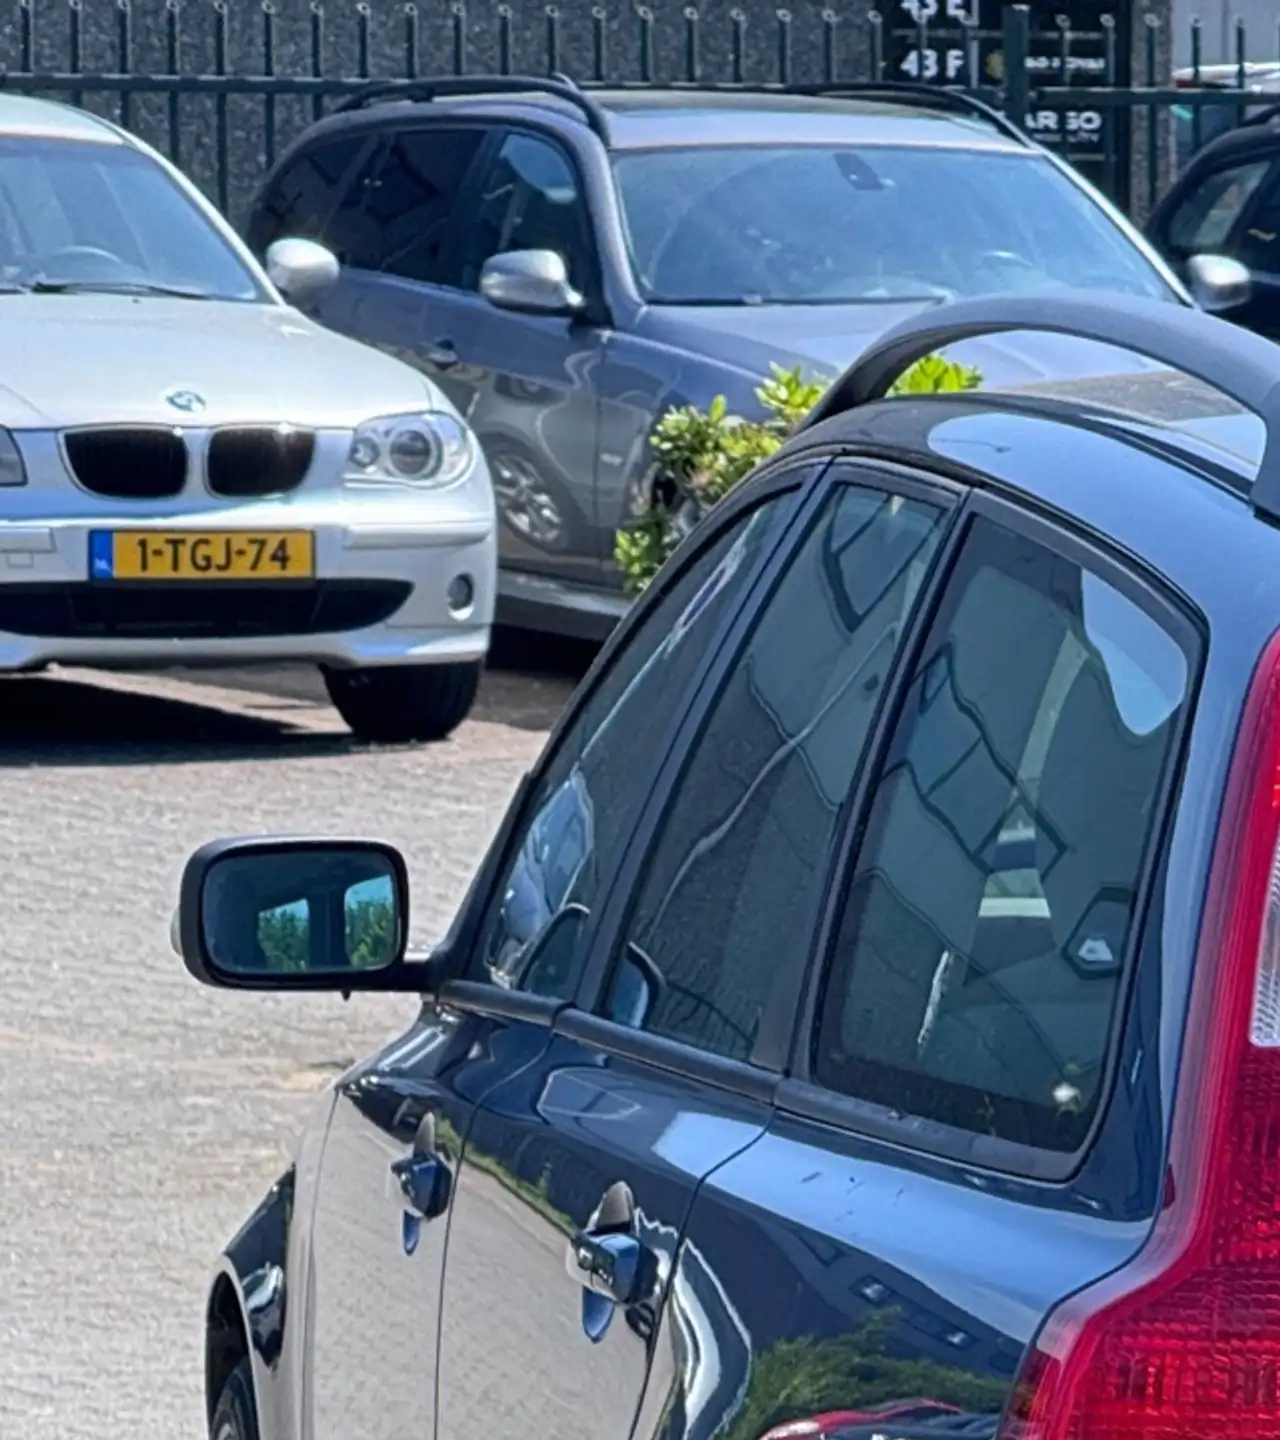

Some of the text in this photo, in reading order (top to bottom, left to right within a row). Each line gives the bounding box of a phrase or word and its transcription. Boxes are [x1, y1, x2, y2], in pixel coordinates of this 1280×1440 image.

[900, 49, 965, 79] 43 F
[136, 537, 291, 572] 1-TGJ-74
